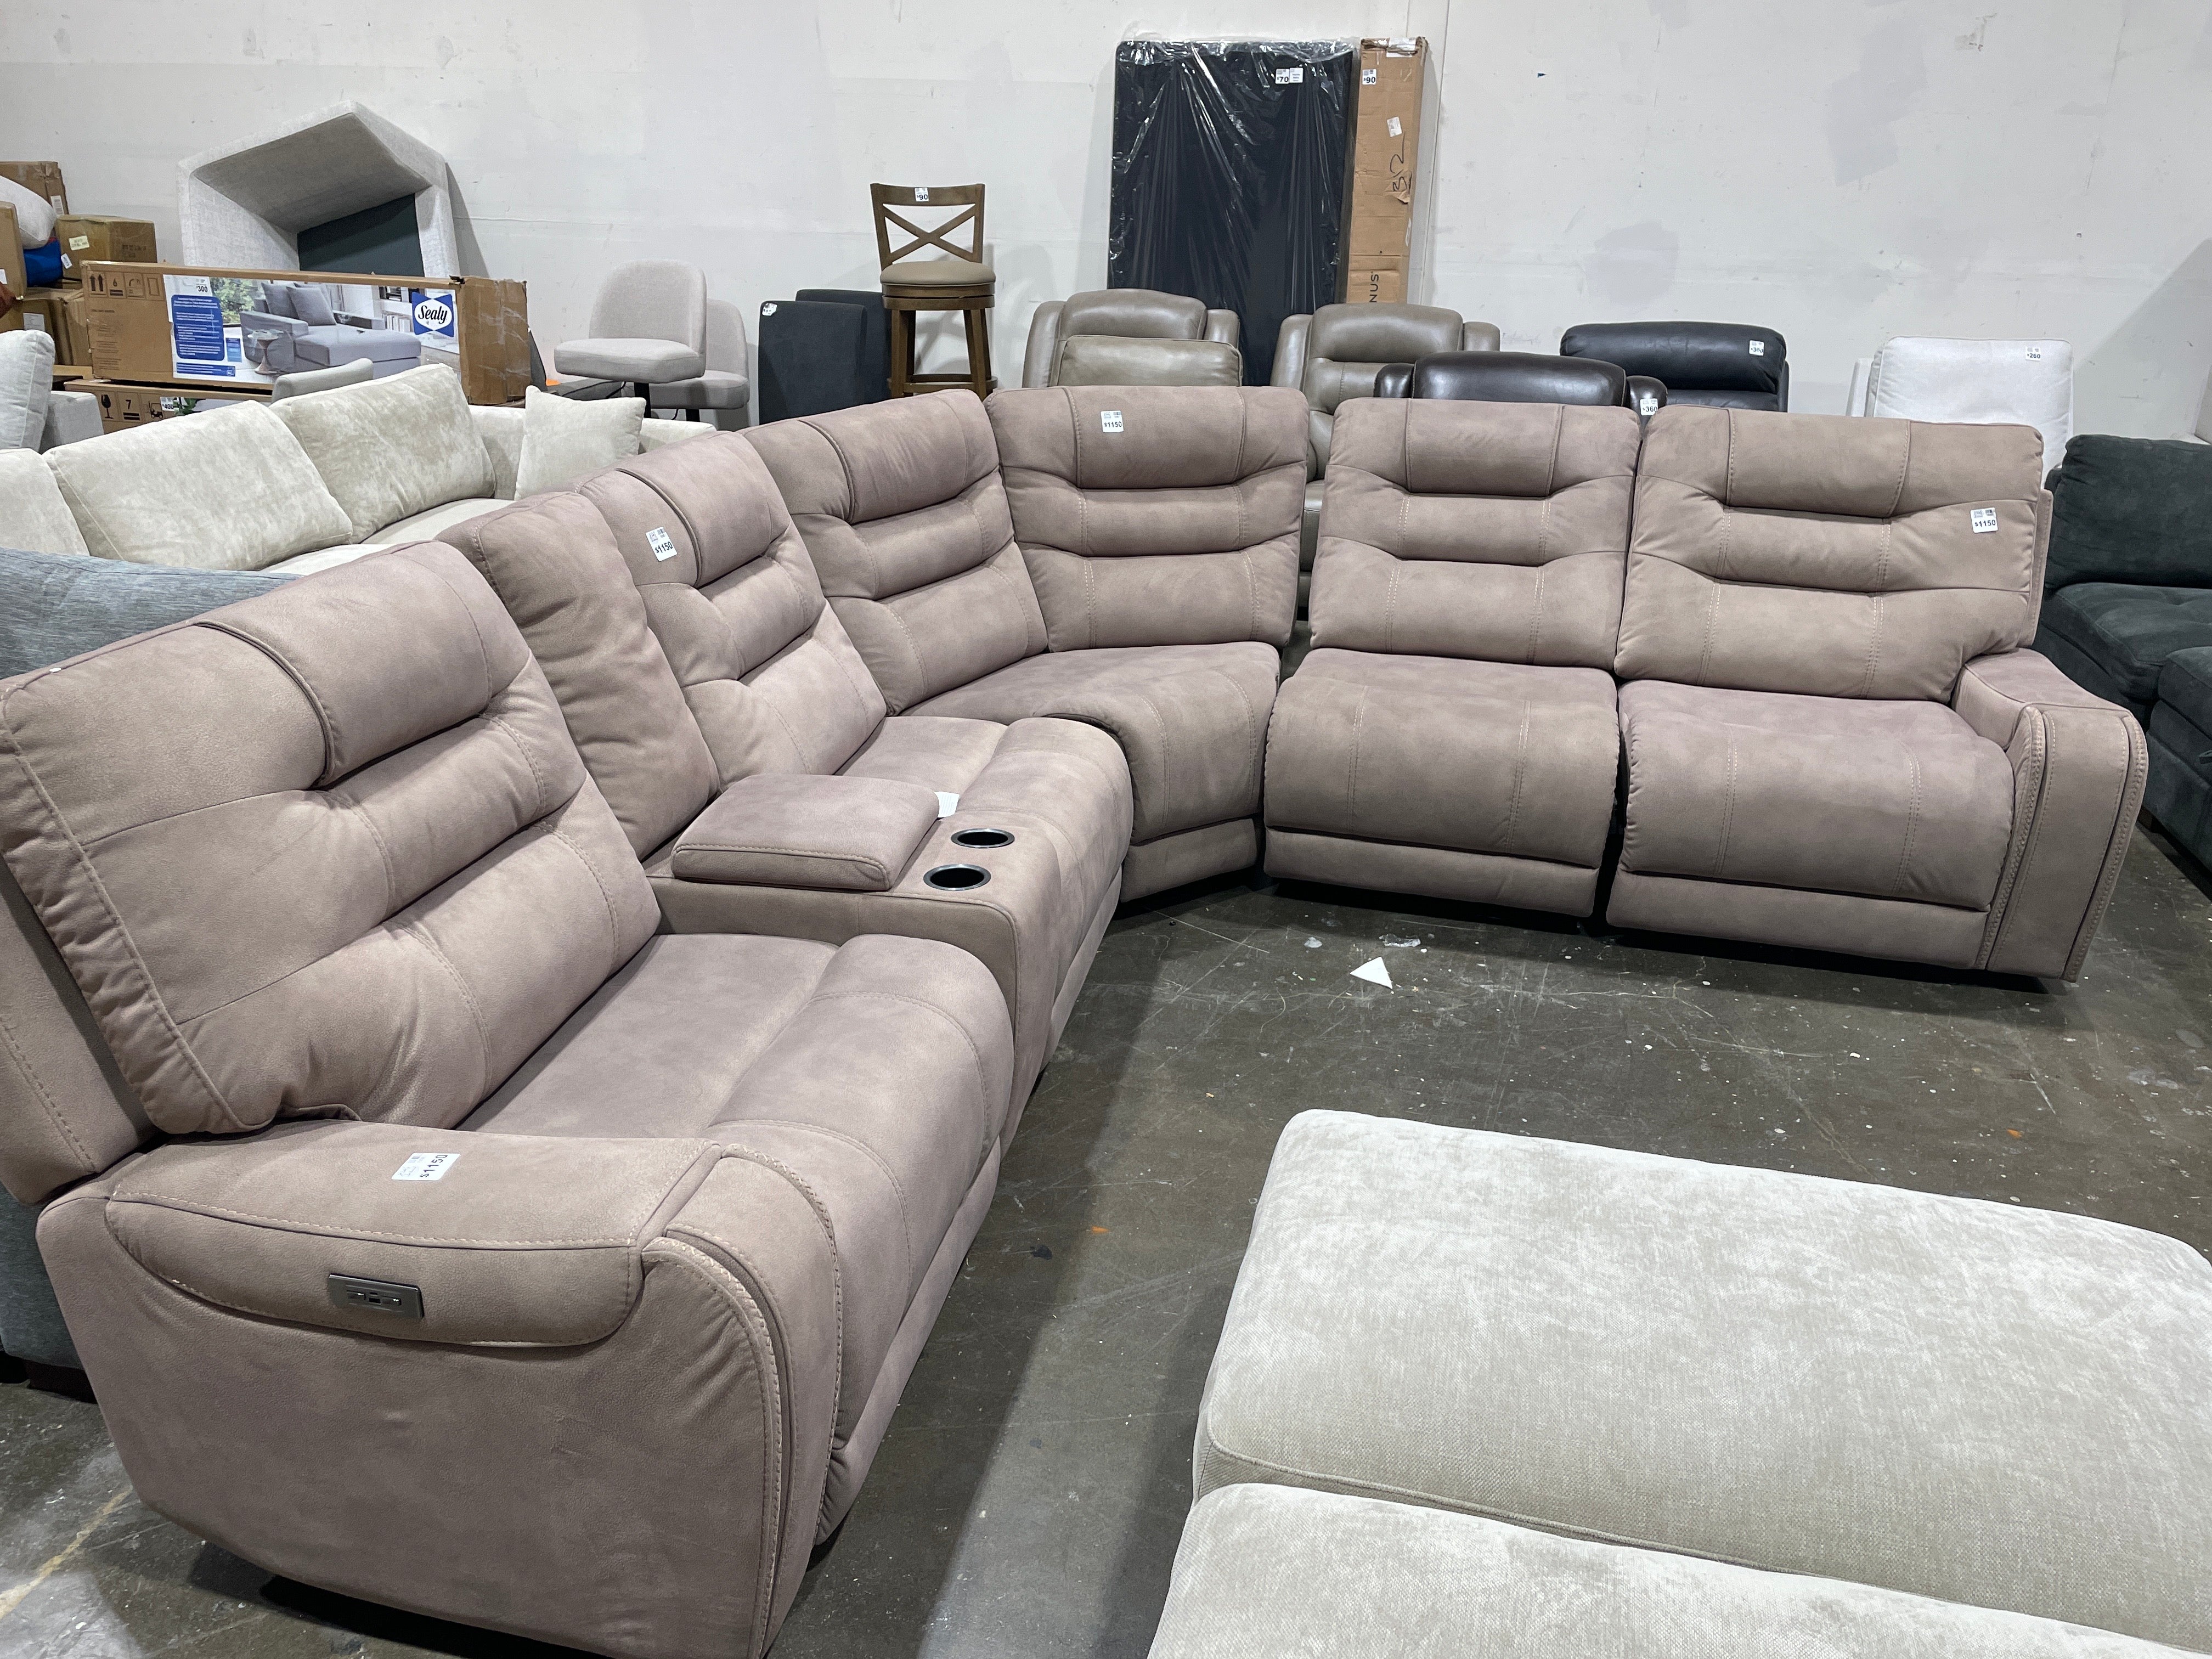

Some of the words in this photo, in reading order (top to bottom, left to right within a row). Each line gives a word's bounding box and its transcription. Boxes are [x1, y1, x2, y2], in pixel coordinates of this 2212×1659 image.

[417, 304, 448, 325] Sealy
[126, 399, 132, 409] 7
[654, 541, 673, 554] $1150
[420, 1154, 448, 1177] $1150
